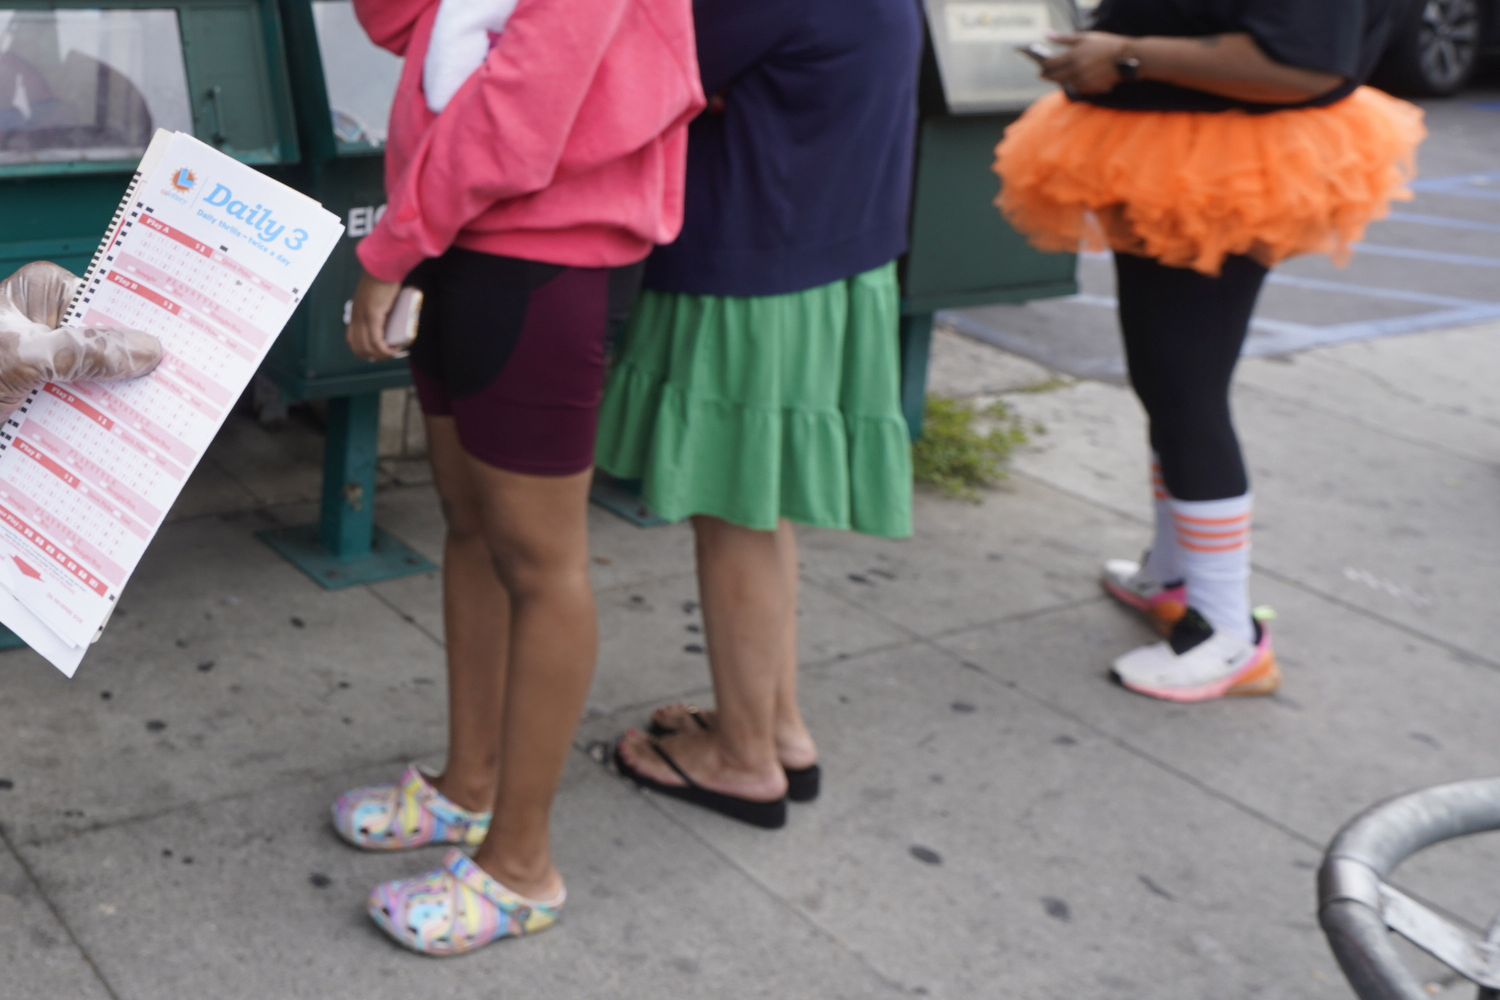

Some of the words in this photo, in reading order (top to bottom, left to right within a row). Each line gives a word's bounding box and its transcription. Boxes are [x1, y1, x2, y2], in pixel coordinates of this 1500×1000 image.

[203, 183, 285, 242] Daily
[284, 228, 309, 250] 3
[146, 218, 162, 230] Play
[196, 209, 216, 224] Daily
[217, 221, 241, 237] thrills
[248, 237, 268, 252] twice
[276, 254, 291, 266] day
[114, 275, 130, 287] Play
[50, 386, 66, 399] Play
[19, 443, 34, 456] Play
